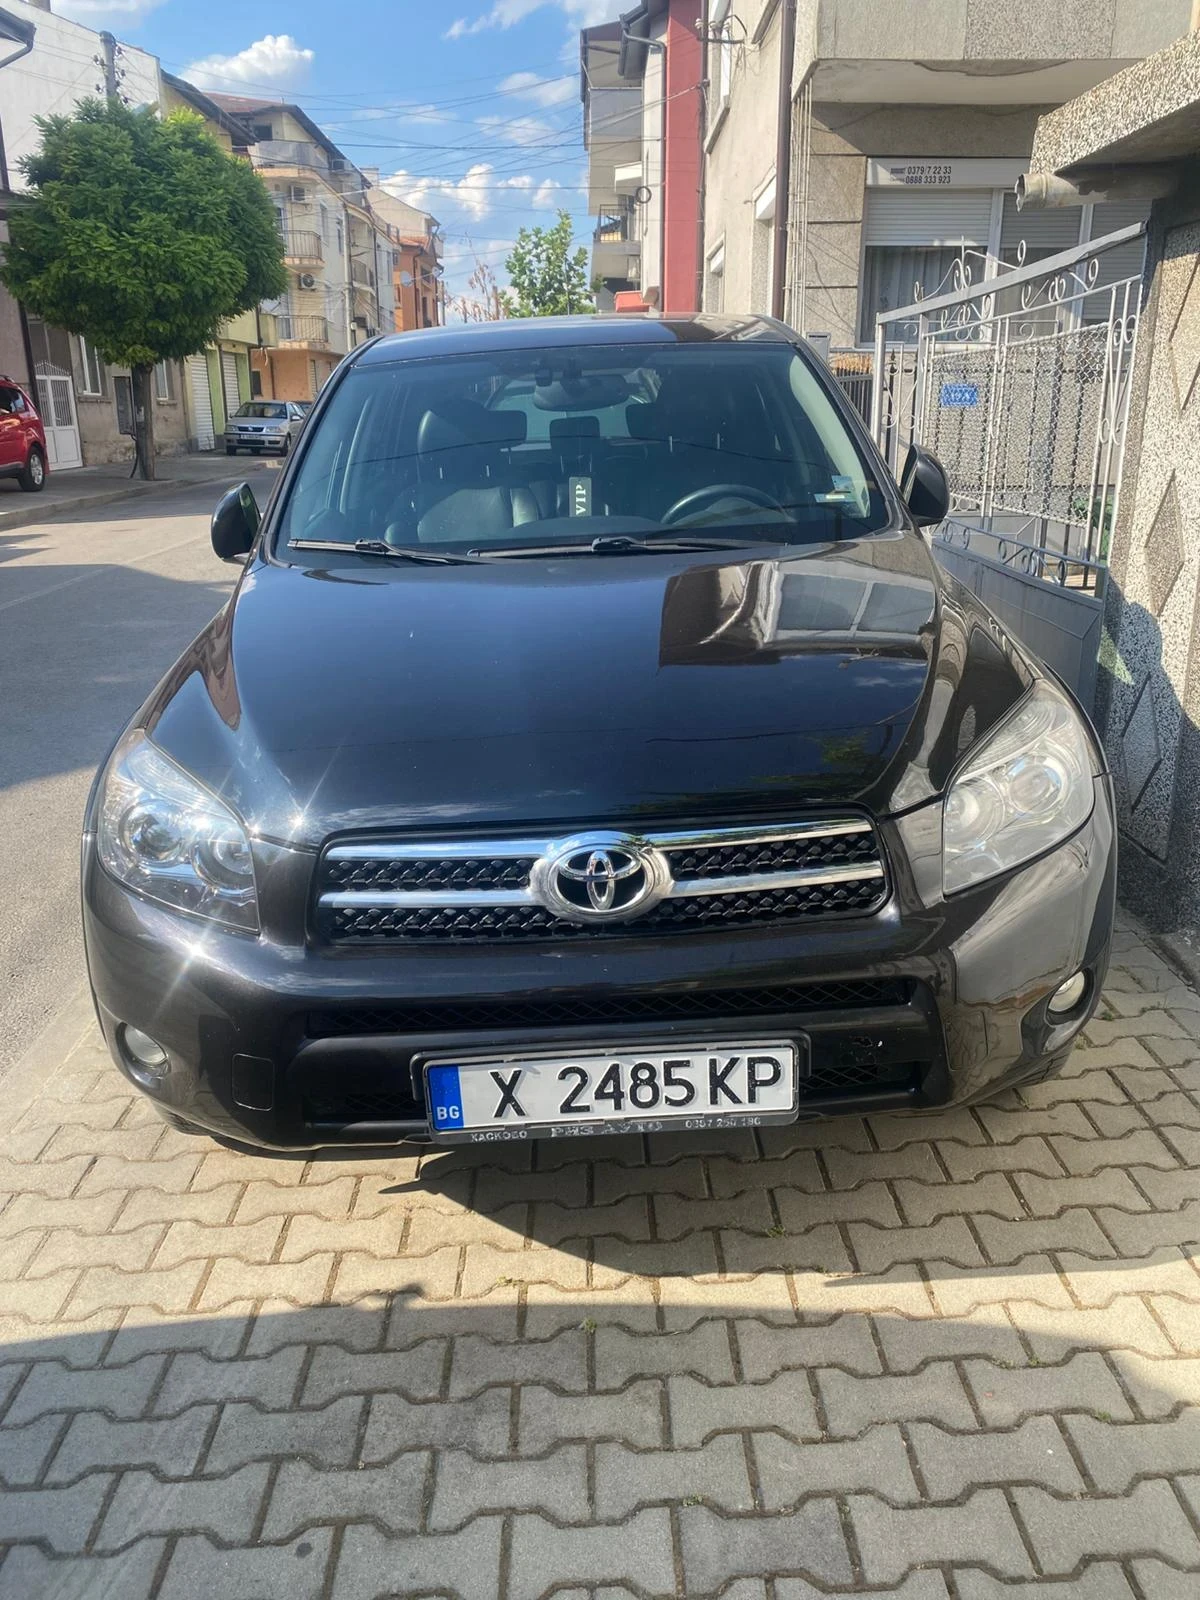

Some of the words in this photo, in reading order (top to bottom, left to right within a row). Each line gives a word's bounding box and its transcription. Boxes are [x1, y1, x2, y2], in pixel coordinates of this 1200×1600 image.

[924, 175, 937, 184] 333
[938, 175, 951, 184] 923
[575, 484, 587, 516] VIP
[557, 1060, 695, 1114] 2485
[437, 1106, 460, 1120] BG
